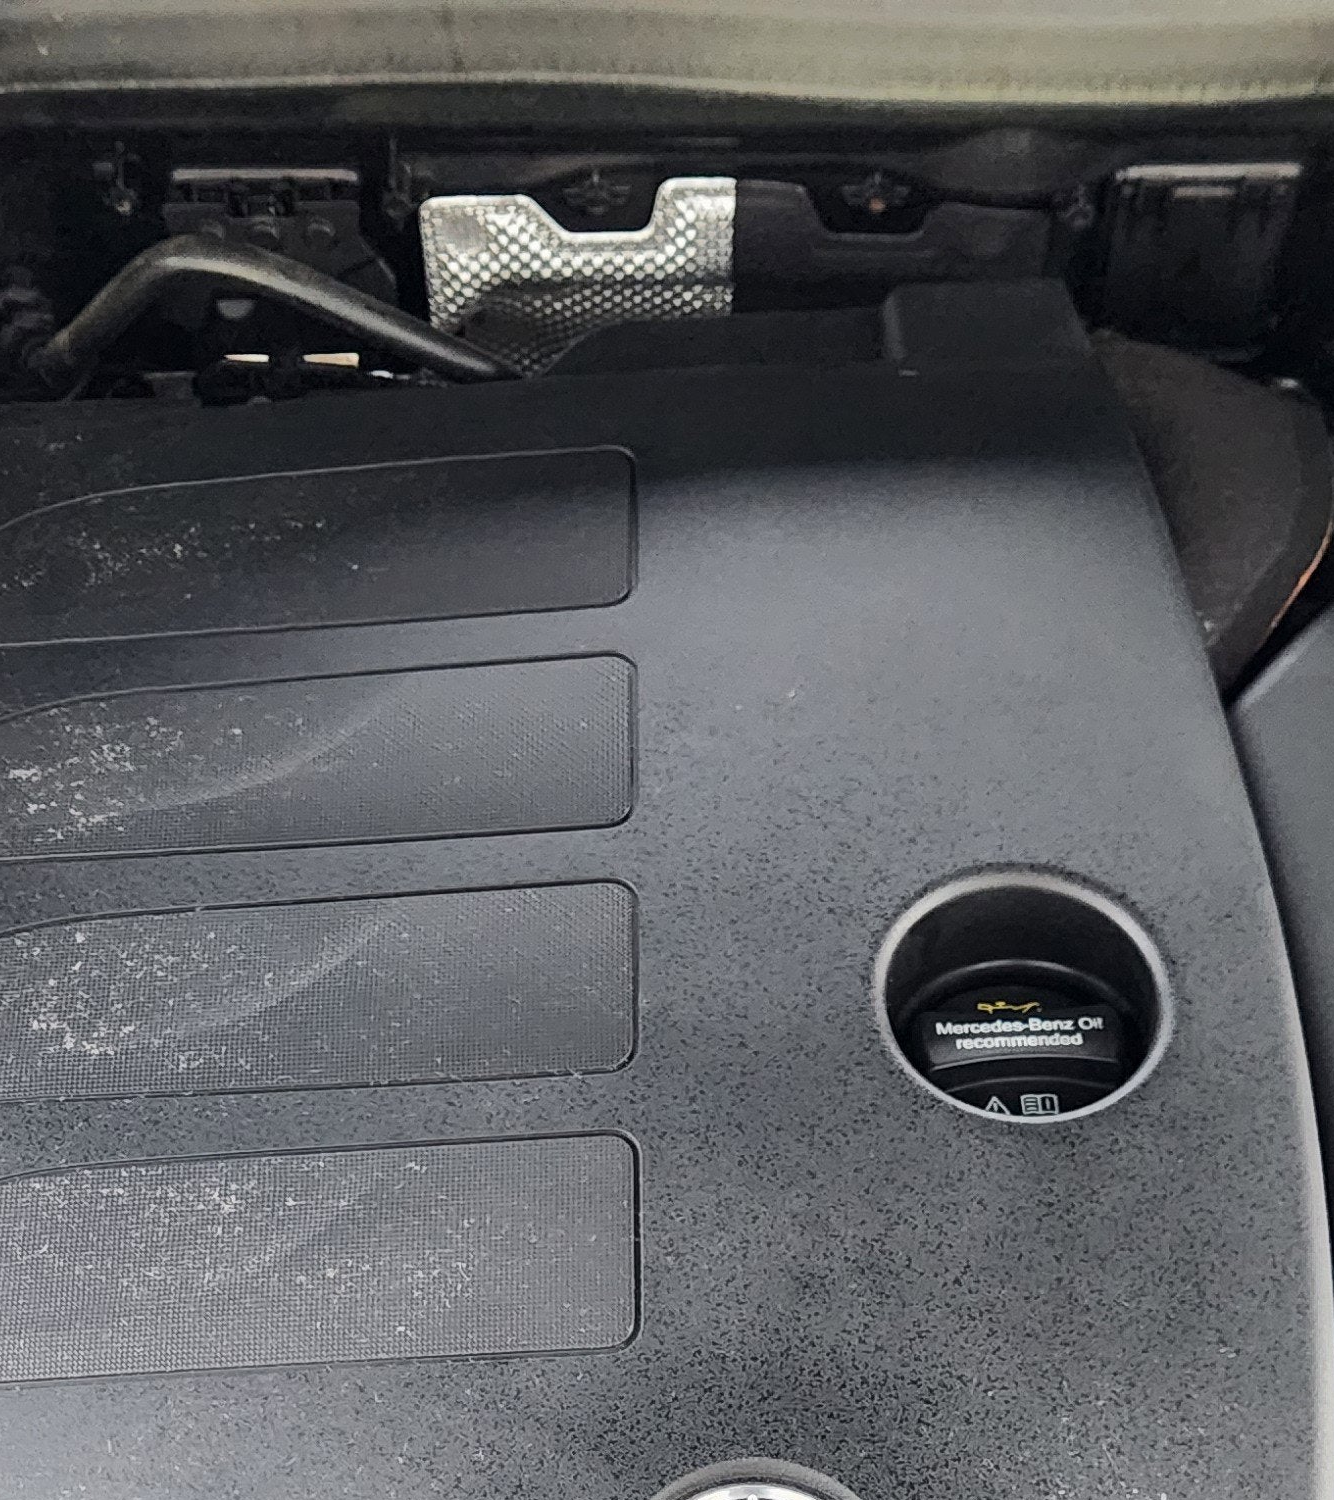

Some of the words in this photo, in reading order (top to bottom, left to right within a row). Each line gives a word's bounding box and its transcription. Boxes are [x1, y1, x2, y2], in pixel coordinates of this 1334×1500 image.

[935, 1017, 1075, 1036] Mercedes-Benz
[1078, 1016, 1104, 1030] Oil
[955, 1032, 1084, 1050] recommended
